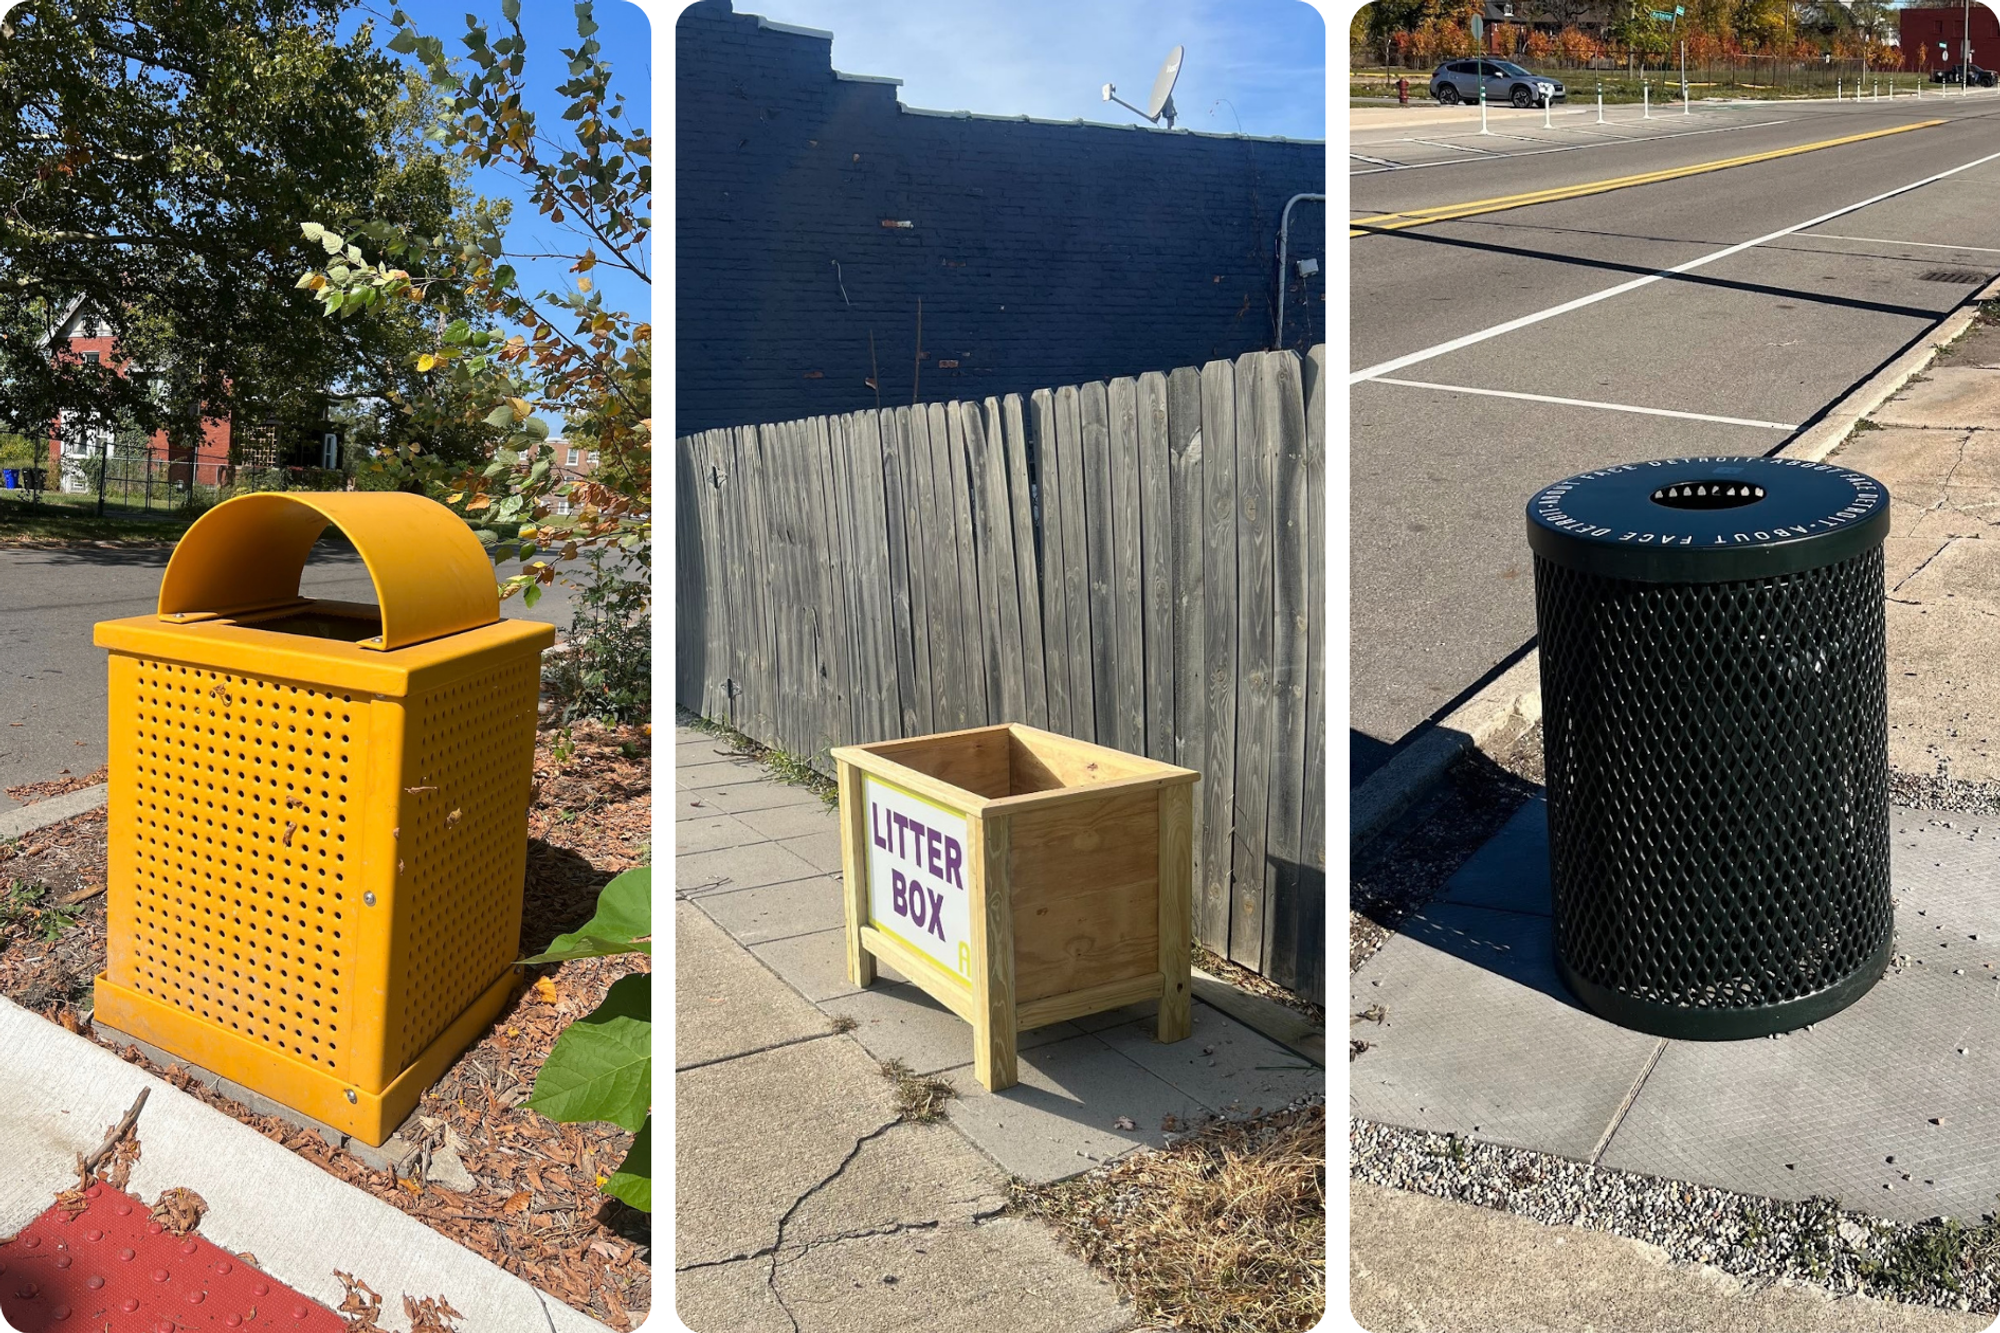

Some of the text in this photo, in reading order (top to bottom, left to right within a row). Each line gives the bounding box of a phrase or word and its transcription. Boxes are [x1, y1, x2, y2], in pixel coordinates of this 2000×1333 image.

[1619, 531, 1693, 545] FACE
[1714, 524, 1808, 544] ABOUT
[872, 801, 964, 891] LITTER
[891, 868, 946, 943] BOX
